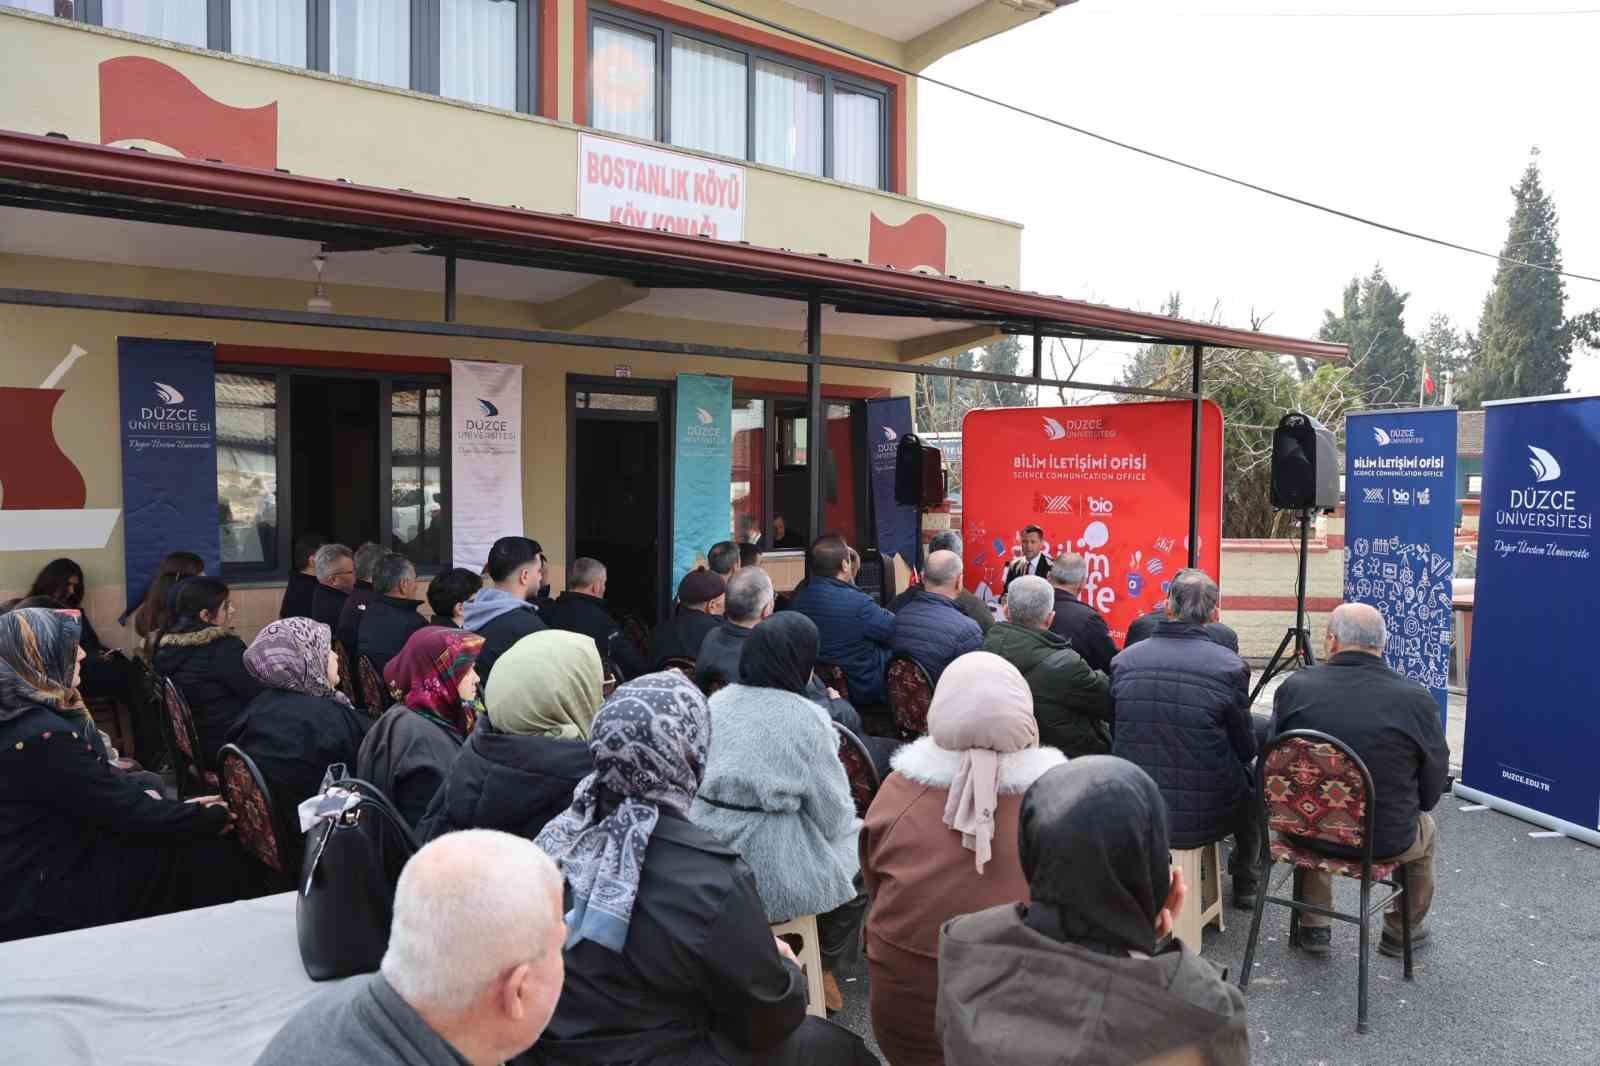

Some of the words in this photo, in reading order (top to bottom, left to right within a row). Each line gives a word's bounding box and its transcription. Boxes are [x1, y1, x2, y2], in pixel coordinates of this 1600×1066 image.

[587, 151, 690, 201] BOSTANLIK
[693, 168, 741, 210] KÖYÜ
[141, 406, 198, 421] DÜZCE
[466, 418, 508, 432] DÜZCE
[1066, 418, 1104, 430] DÜZCE
[1013, 453, 1046, 469] BİLİM
[1049, 453, 1107, 472] İLETİŞİMİ
[1110, 453, 1147, 470] OFİSİ
[1354, 456, 1376, 469] BİLİM
[1378, 455, 1418, 470] İLETİŞİMİ
[1419, 455, 1445, 469] OFİSİ
[1013, 471, 1044, 480] SCIENCE
[1046, 472, 1114, 481] COMMUNICATION
[1116, 472, 1147, 481] OFFICE
[1392, 488, 1410, 501] bio
[1510, 487, 1576, 511] DÜZCE
[1088, 495, 1113, 513] bio
[1495, 510, 1593, 530] ÜNİVERSİTESİ
[1502, 769, 1551, 792] DUZCE.EDU.TR
